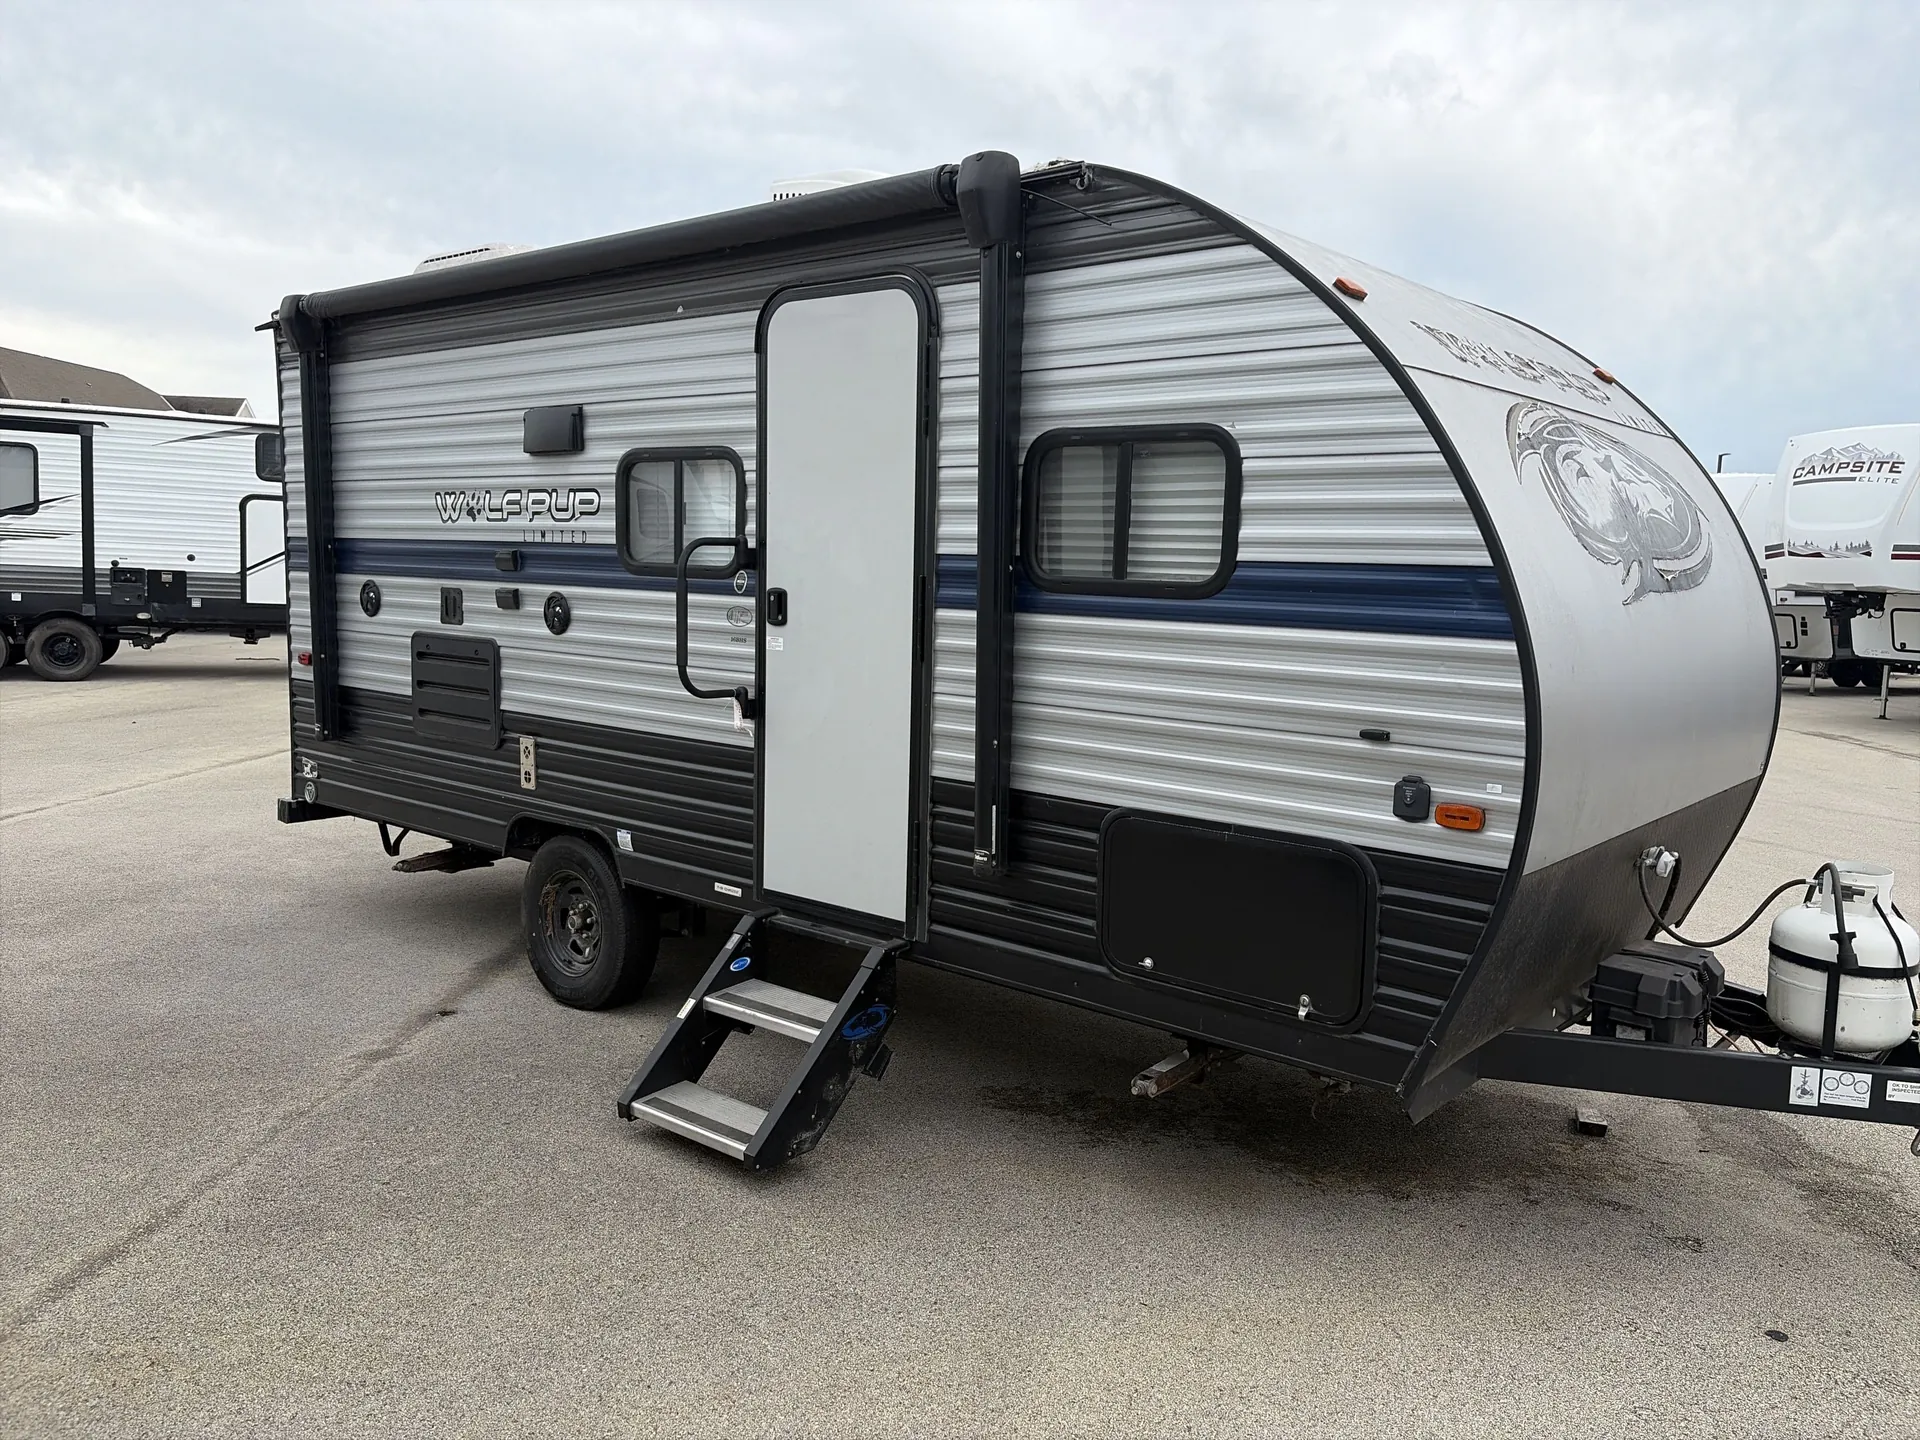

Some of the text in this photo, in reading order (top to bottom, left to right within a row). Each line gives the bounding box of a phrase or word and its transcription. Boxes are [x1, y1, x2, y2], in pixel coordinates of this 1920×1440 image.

[1792, 460, 1906, 480] CAMPSITE
[1858, 476, 1900, 485] ELITE
[522, 529, 588, 543] LIMITED
